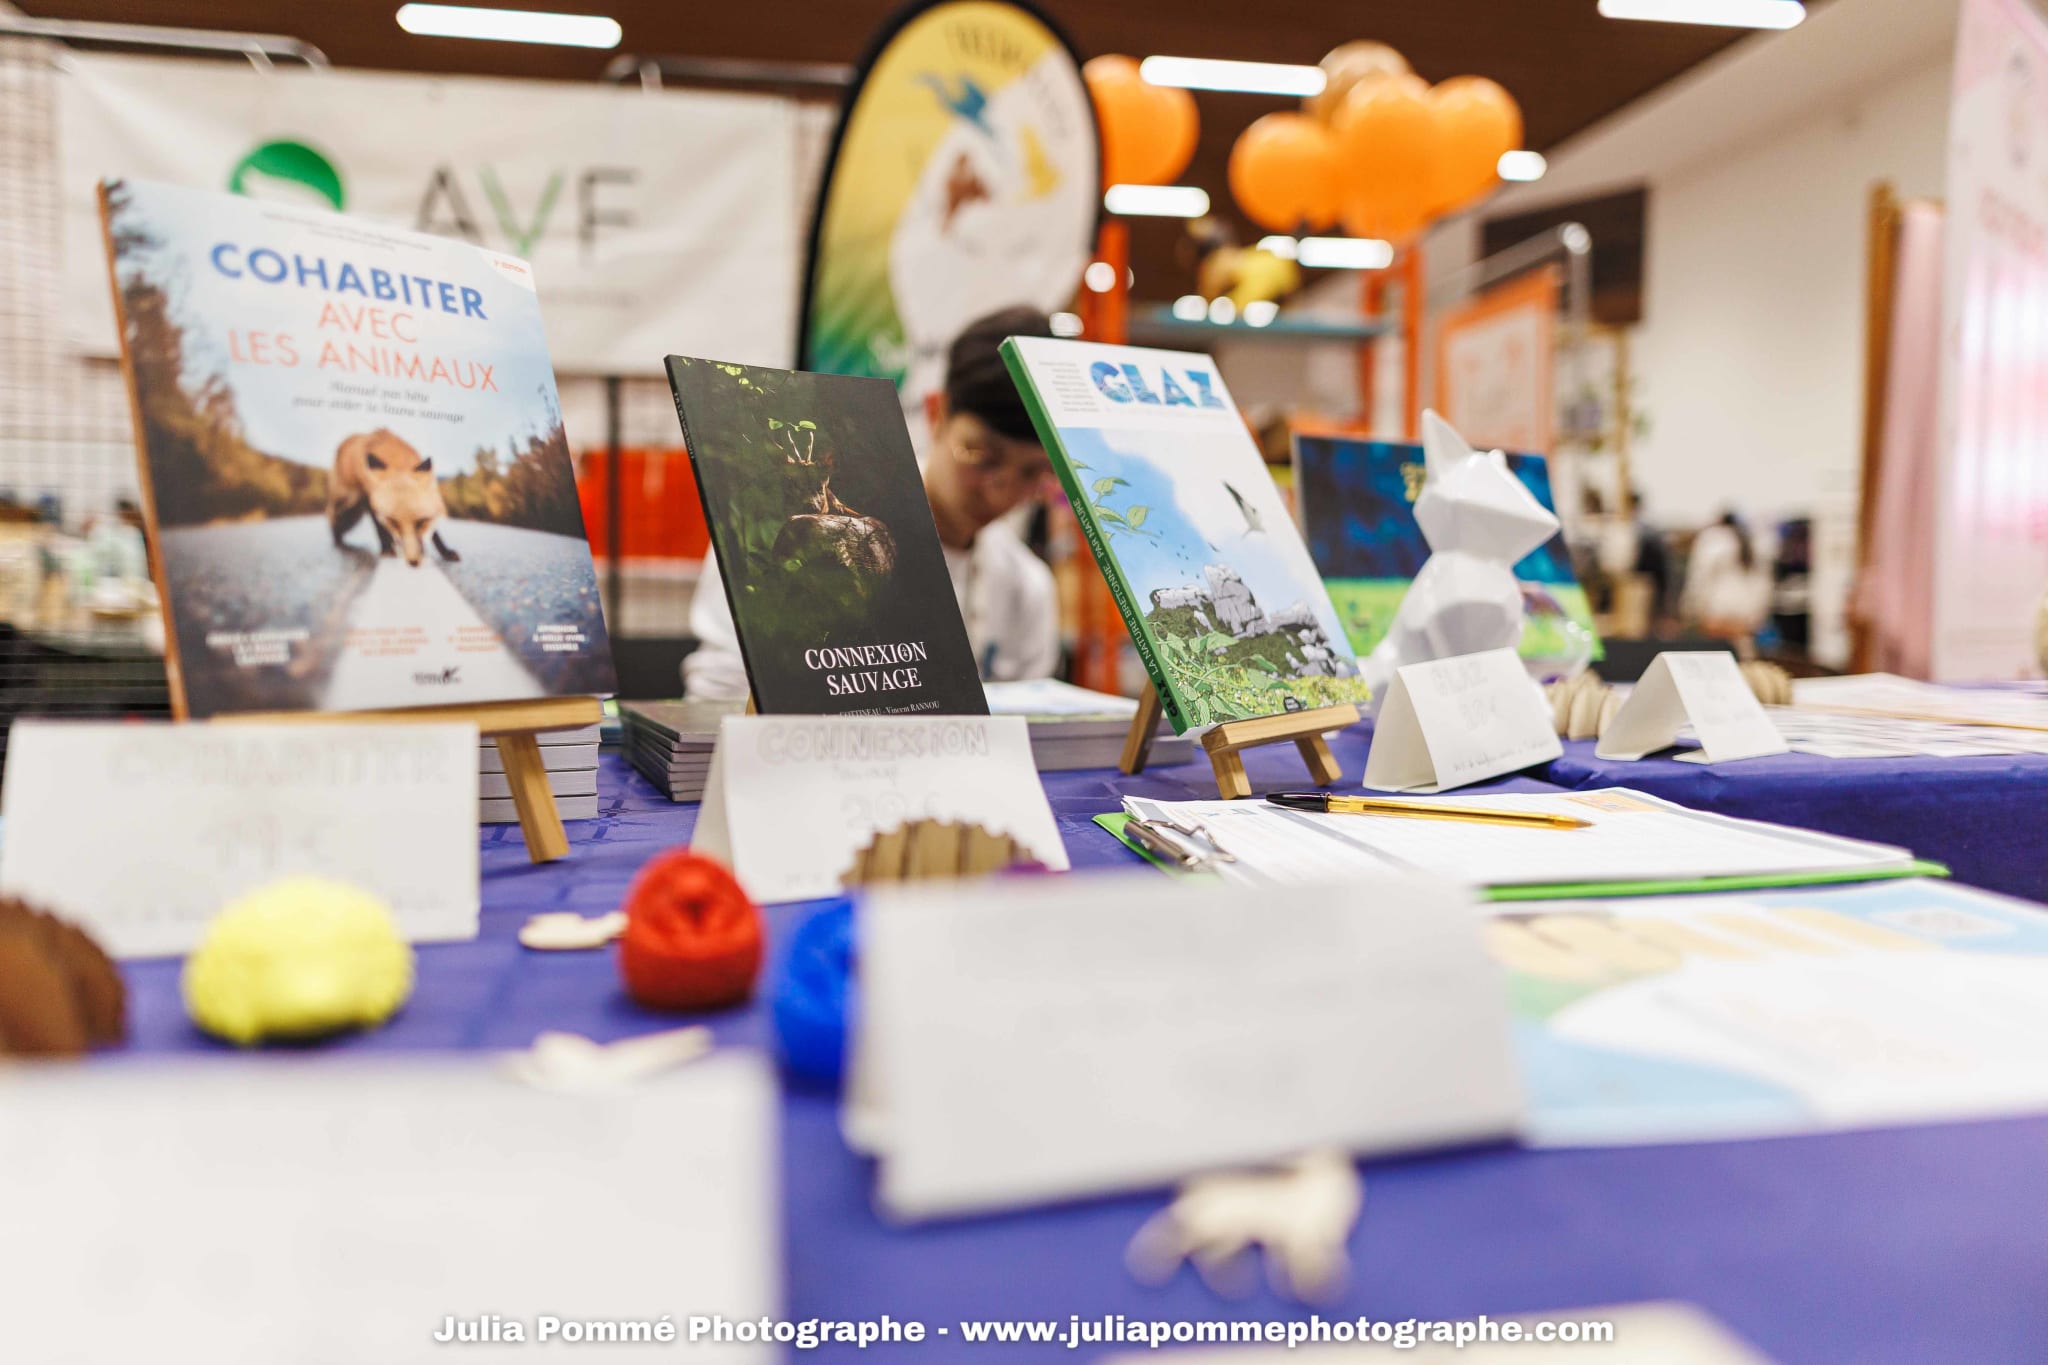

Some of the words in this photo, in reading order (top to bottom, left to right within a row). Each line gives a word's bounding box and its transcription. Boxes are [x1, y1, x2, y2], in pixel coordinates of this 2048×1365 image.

[210, 242, 489, 321] COHABITER
[318, 302, 418, 344] AVEC
[229, 330, 299, 367] LES
[317, 341, 499, 393] ANIMAUX
[1090, 361, 1227, 411] GLAZ
[1073, 497, 1096, 539] NATURE
[1092, 538, 1105, 559] PAR
[805, 641, 928, 671] CONNEXION
[1128, 618, 1151, 660] NATURE
[826, 667, 923, 696] SAUVAGE
[1149, 660, 1159, 676] LA
[910, 700, 940, 712] RANNOU
[1157, 680, 1178, 717] GLAZ
